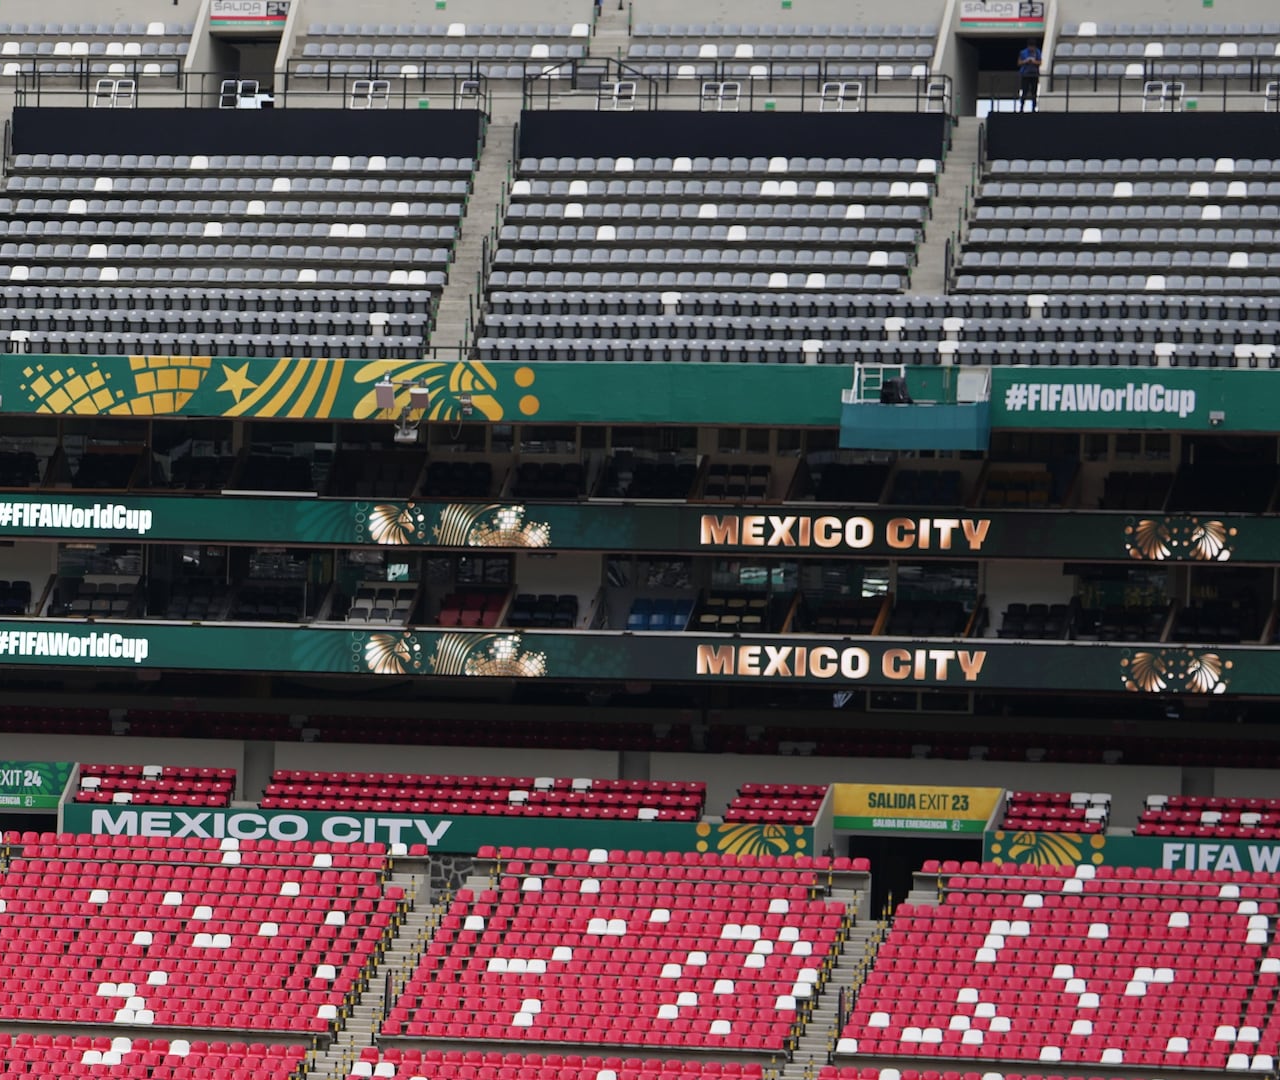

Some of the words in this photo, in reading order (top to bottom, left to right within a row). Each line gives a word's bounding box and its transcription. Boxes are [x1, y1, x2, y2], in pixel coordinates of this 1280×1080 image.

[214, 2, 261, 12] SALIDA
[268, 2, 289, 15] 24
[1020, 3, 1042, 17] 23
[1005, 383, 1195, 418] #FIFAWorldCup
[700, 514, 874, 549] MEXICO
[885, 518, 991, 550] CITY
[695, 644, 870, 679] MEXICO
[881, 649, 987, 682] CITY
[24, 770, 42, 787] 24
[868, 792, 916, 810] SALIDA
[919, 793, 949, 811] EXIT
[951, 794, 969, 811] 23
[91, 808, 309, 842] MEXICO
[321, 816, 453, 847] CITY
[872, 819, 896, 828] SALIDA
[896, 819, 905, 828] DE
[905, 820, 947, 829] EMERGENCIA
[1162, 843, 1242, 873] FIFA
